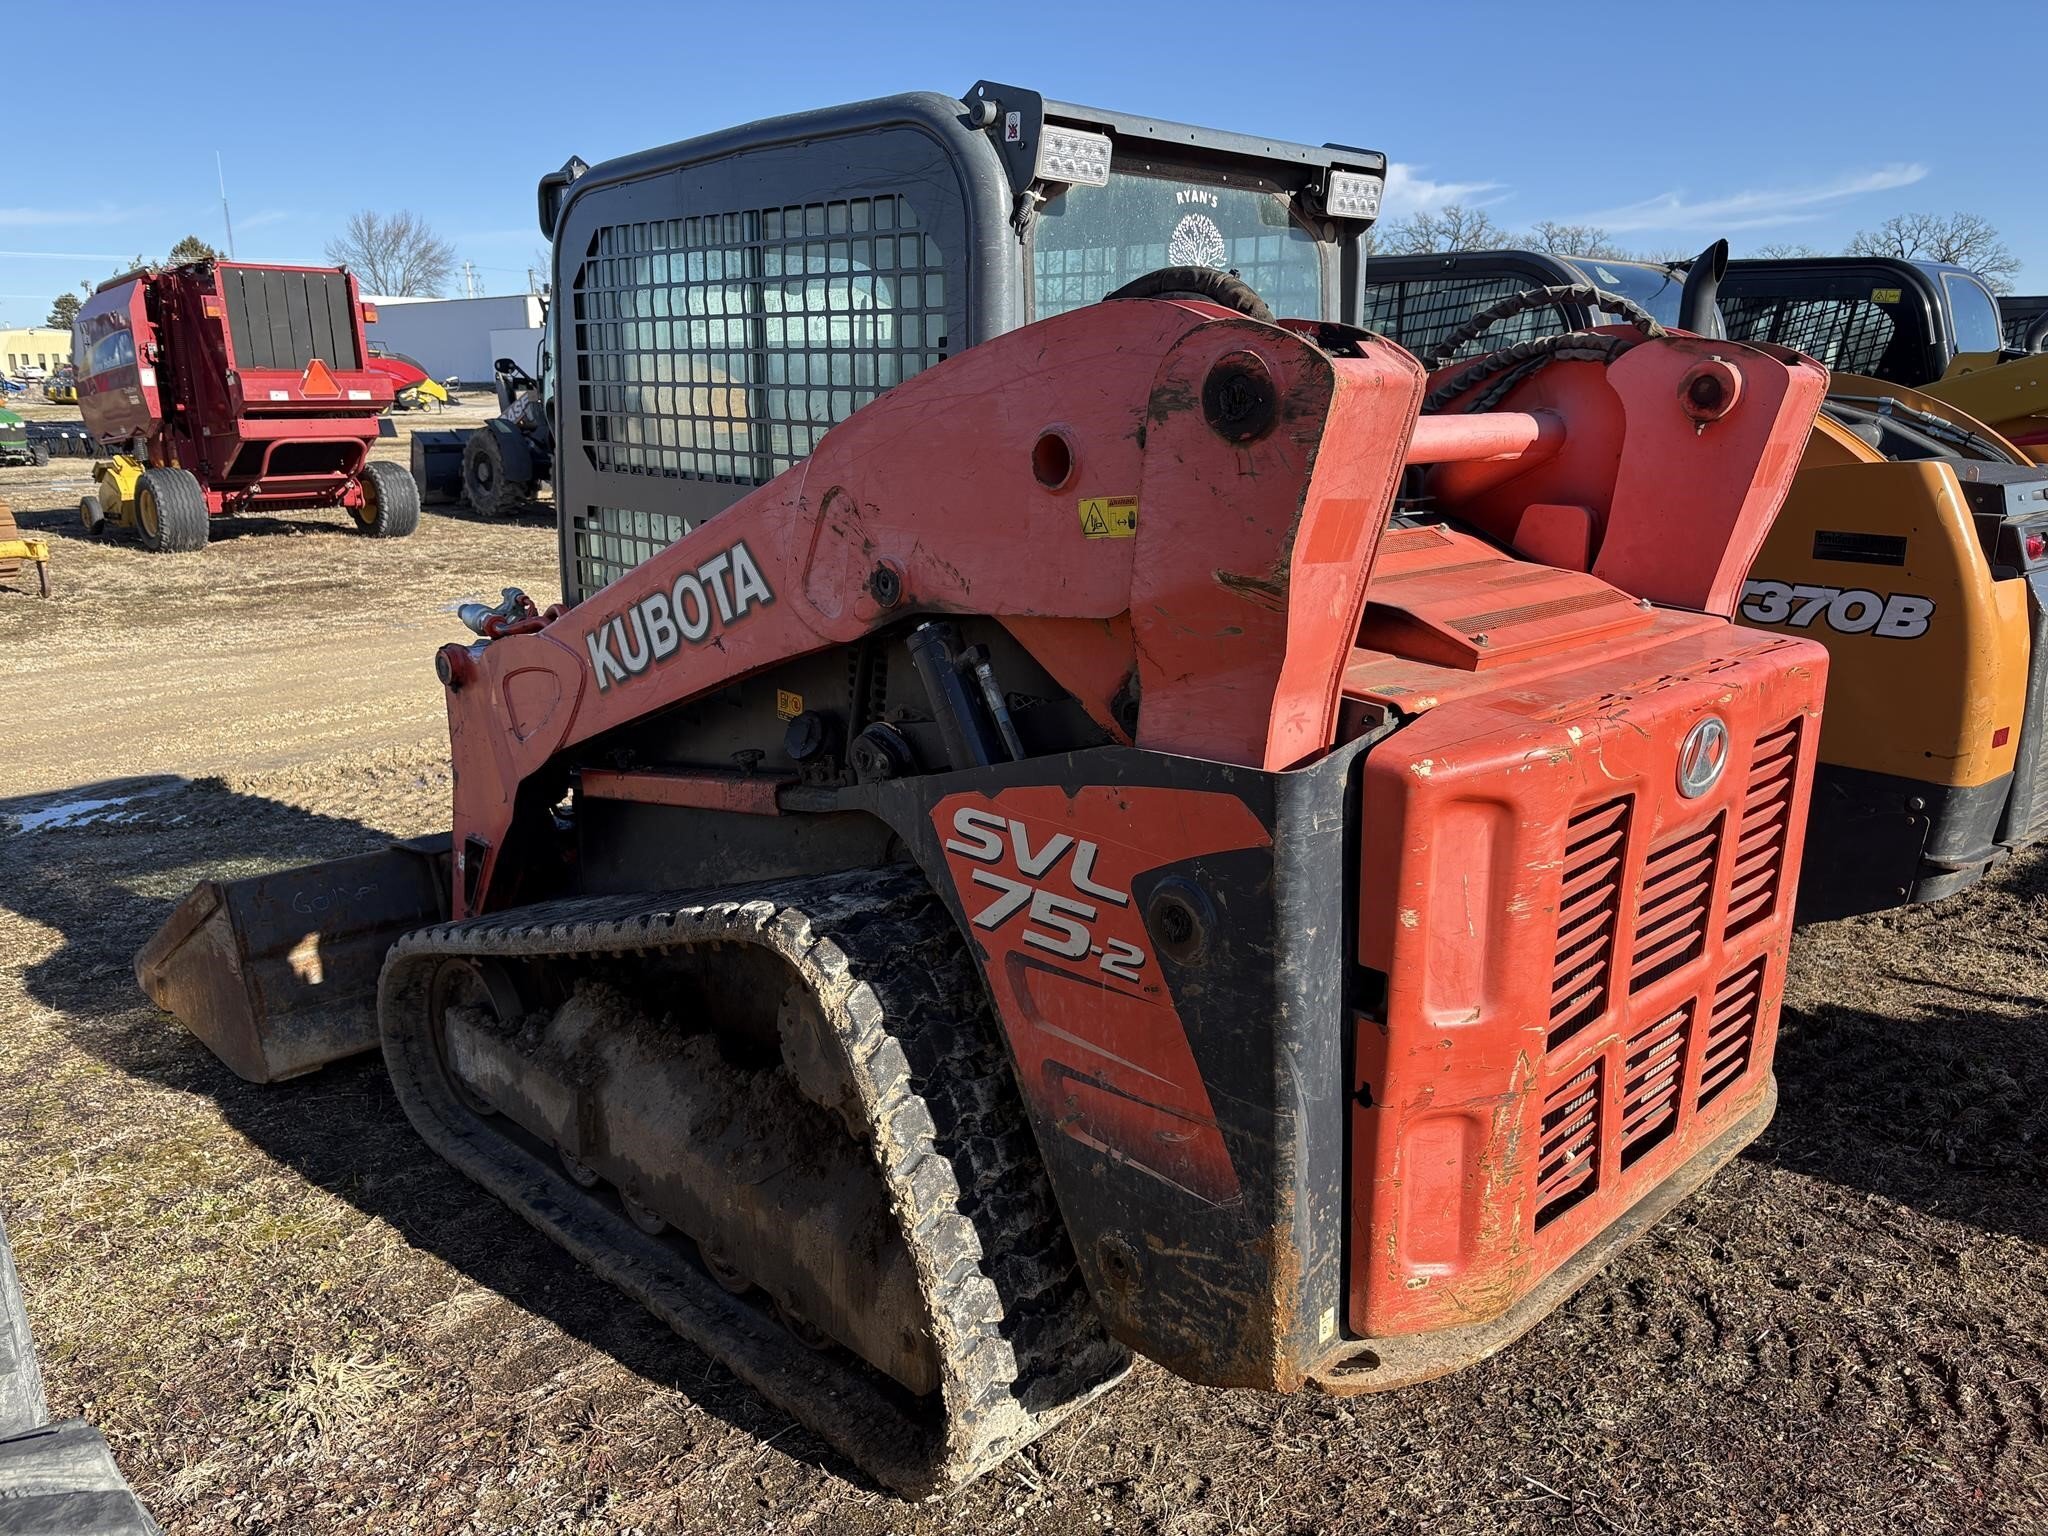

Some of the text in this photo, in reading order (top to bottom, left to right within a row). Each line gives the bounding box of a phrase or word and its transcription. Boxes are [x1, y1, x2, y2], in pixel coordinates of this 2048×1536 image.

[1176, 189, 1218, 208] RYAN'S
[585, 541, 773, 690] KUBOTA
[945, 807, 1130, 907] SVL
[971, 867, 1146, 982] 75-2
